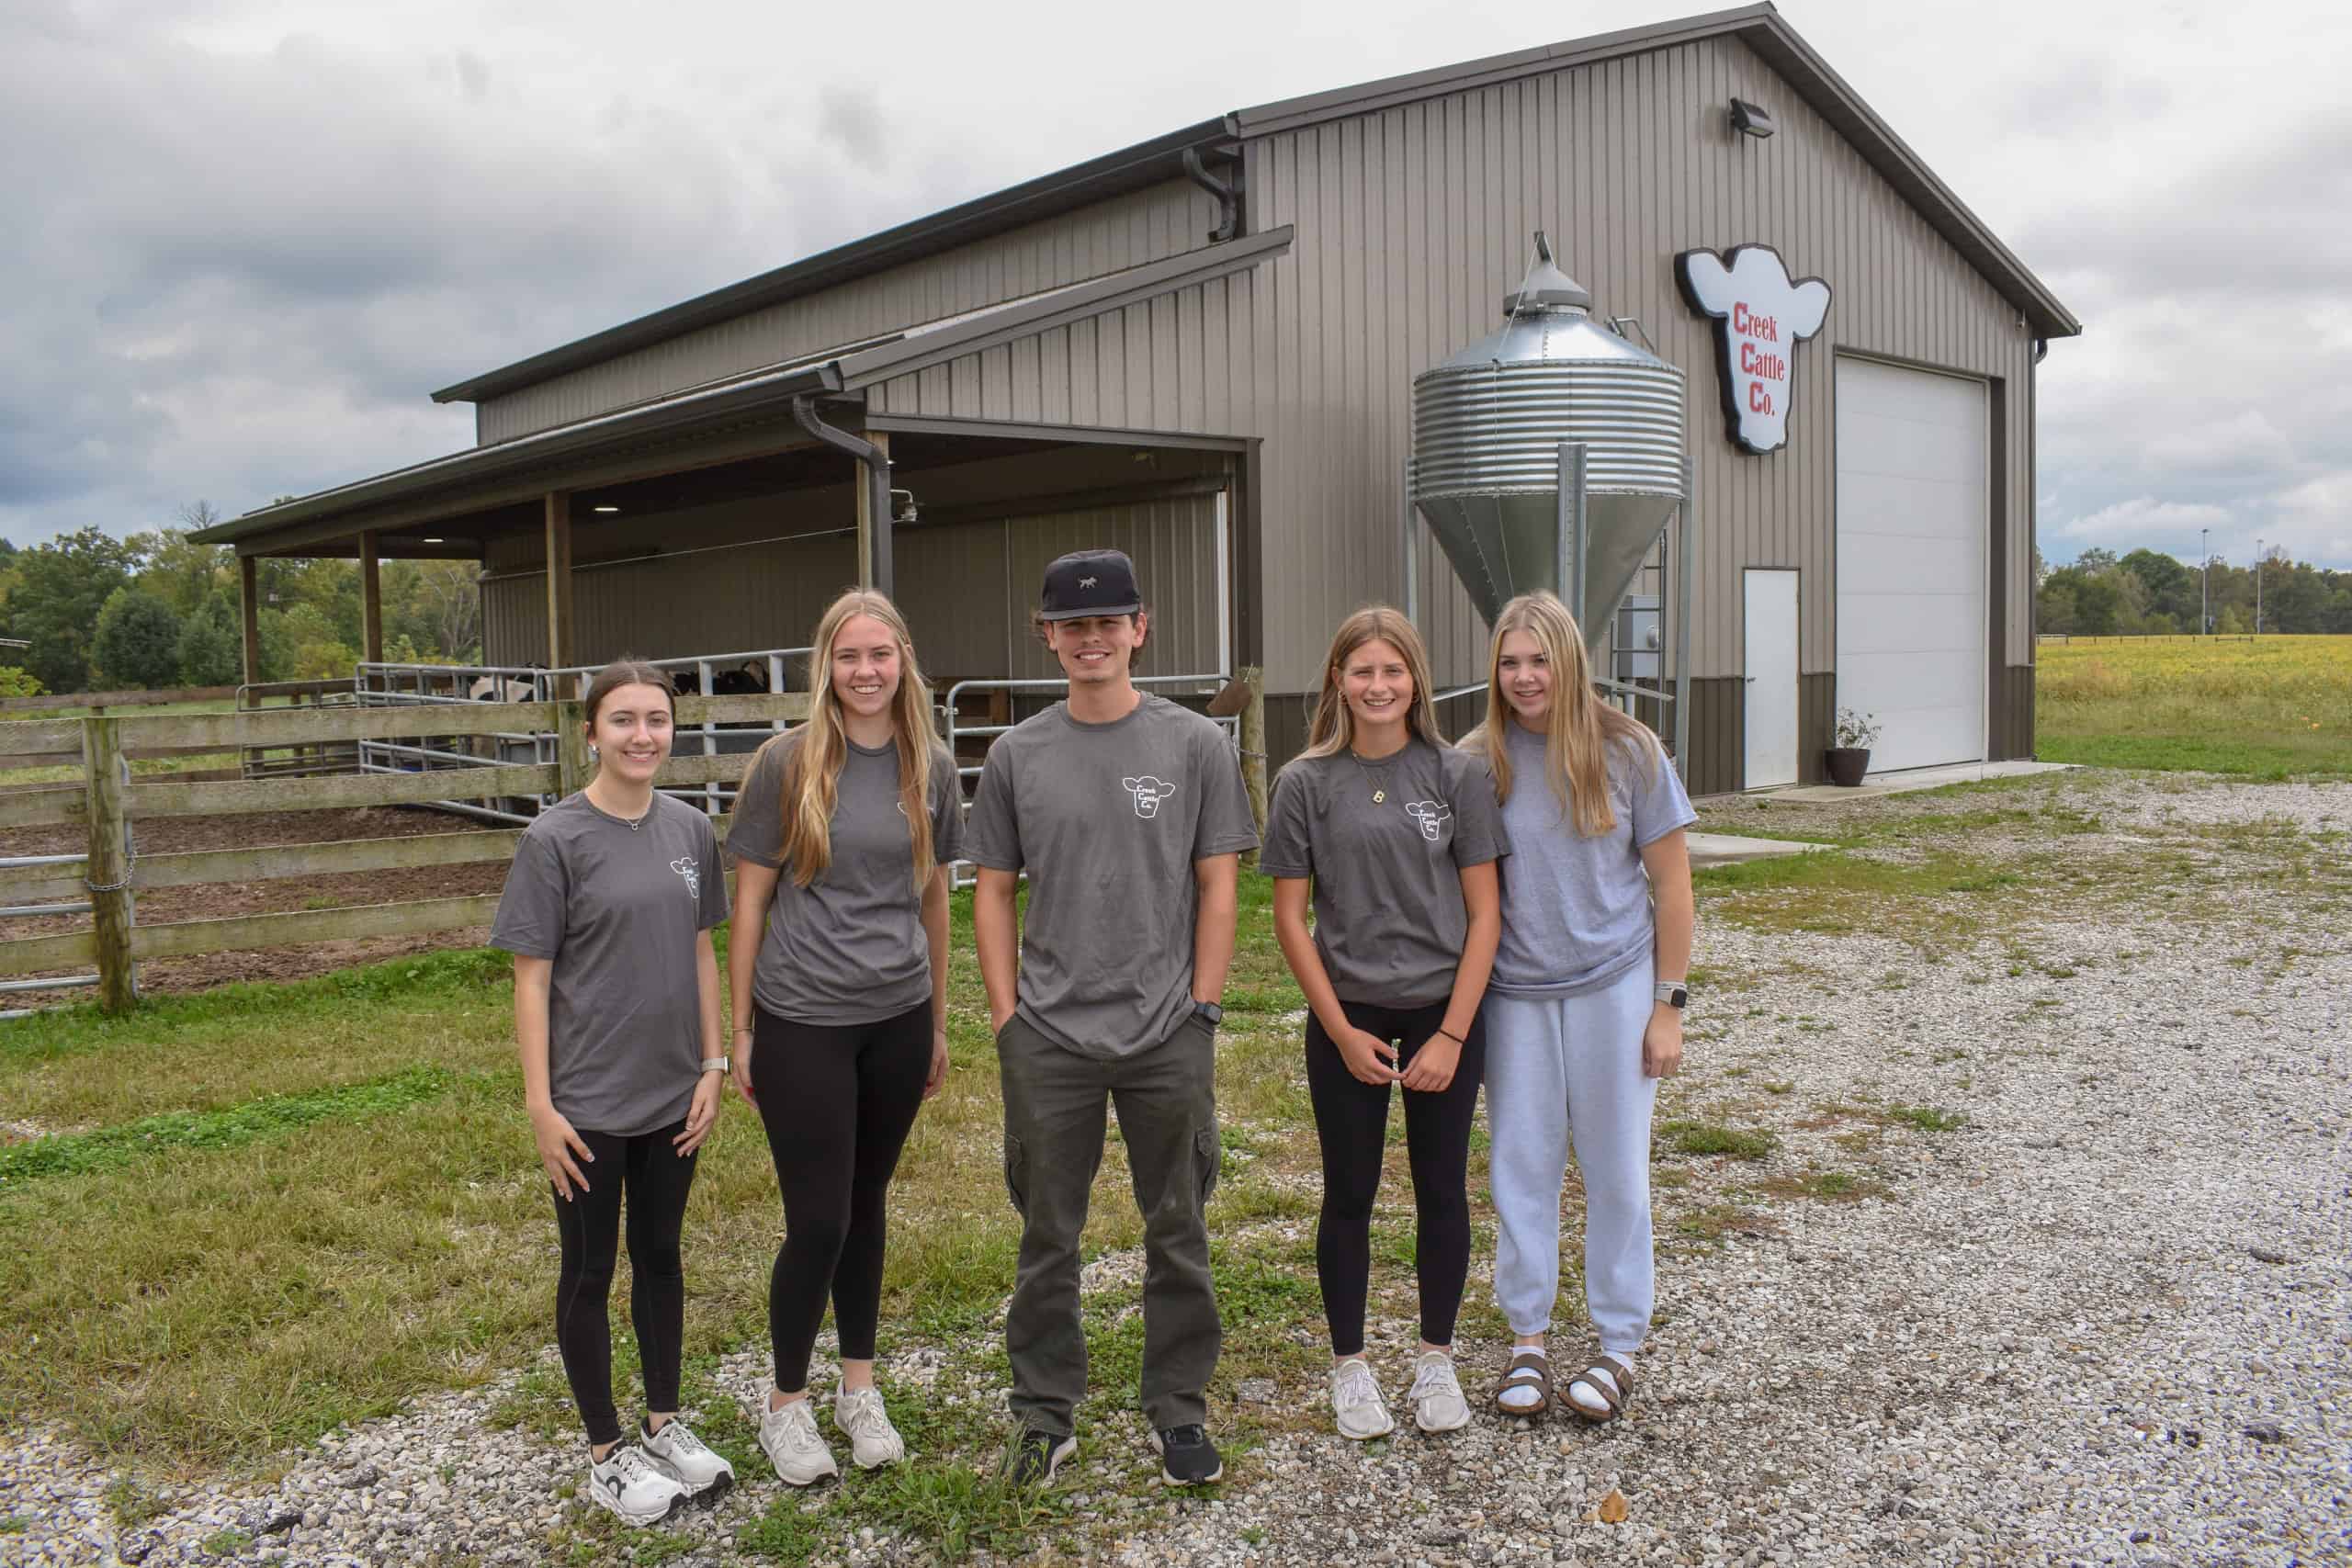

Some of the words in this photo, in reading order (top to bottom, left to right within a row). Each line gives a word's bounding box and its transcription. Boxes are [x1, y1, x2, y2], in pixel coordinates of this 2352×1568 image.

[1734, 301, 1778, 343] Creek
[1741, 341, 1785, 381] Cattle
[1749, 380, 1775, 416] Co.
